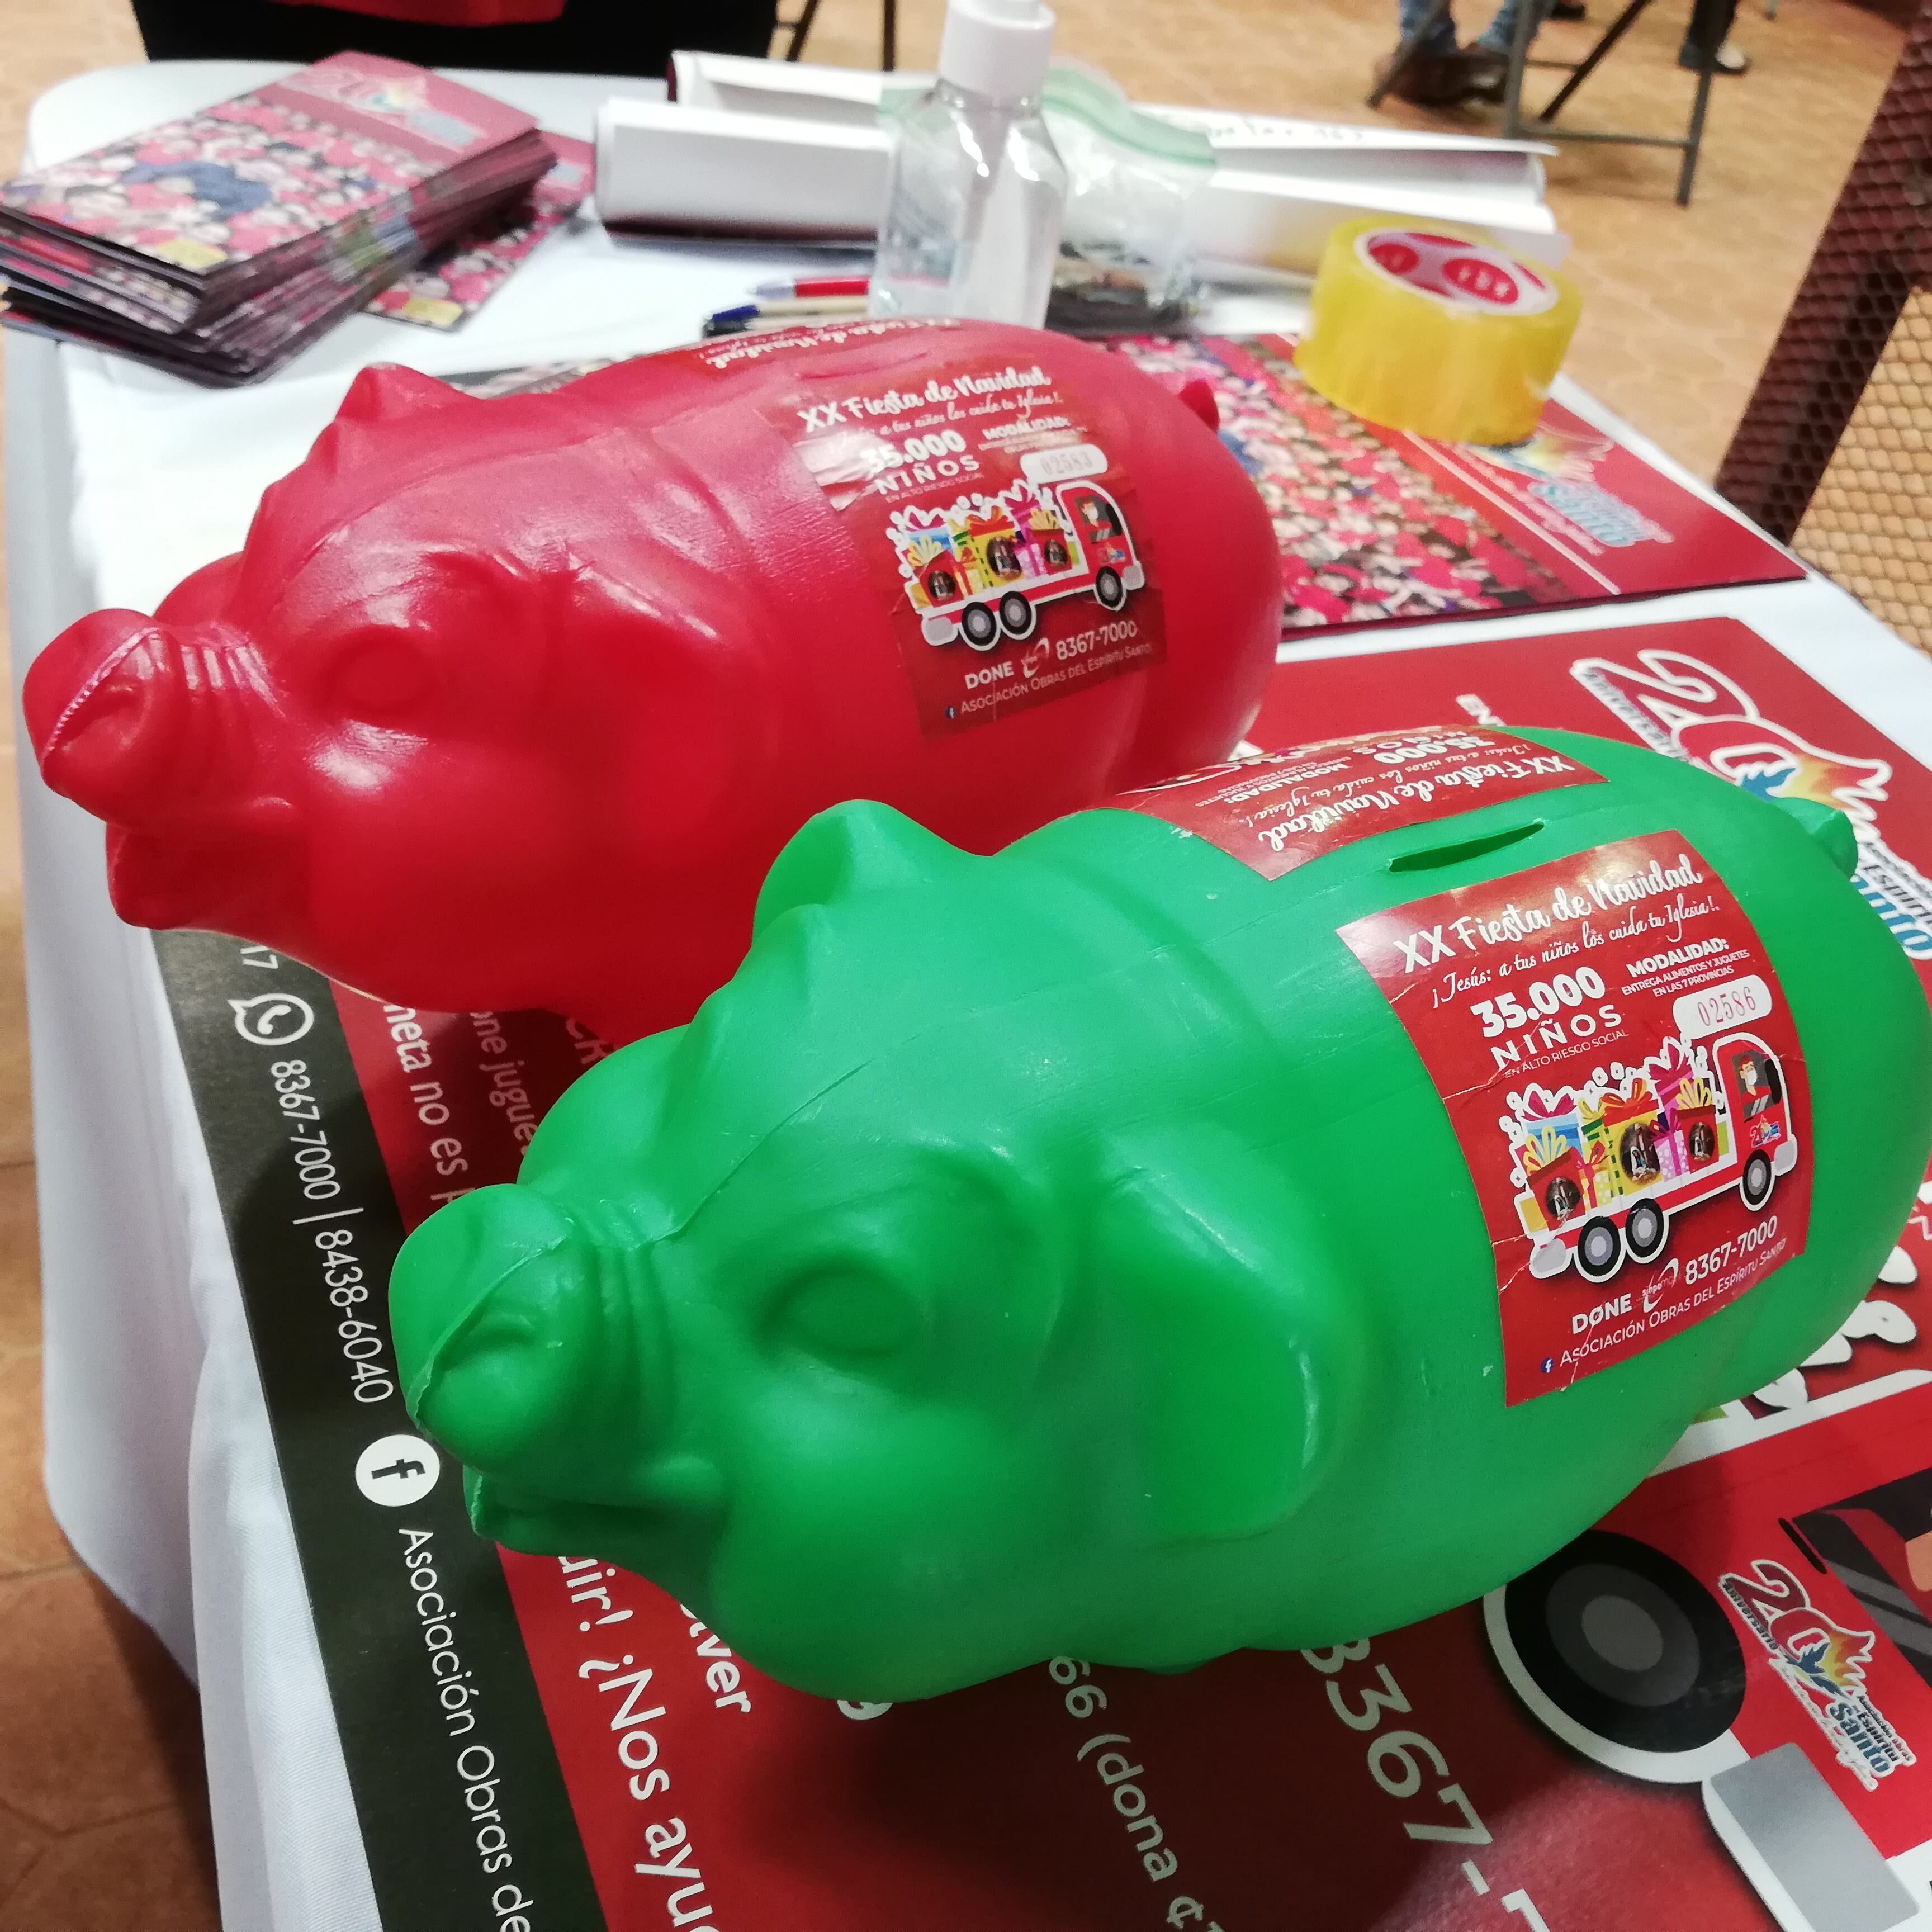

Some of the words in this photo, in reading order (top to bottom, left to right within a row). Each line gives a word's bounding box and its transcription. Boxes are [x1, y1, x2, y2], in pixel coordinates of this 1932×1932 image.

[797, 401, 847, 433] XX
[841, 389, 924, 418] Fiesta
[924, 380, 958, 402] de
[953, 366, 1052, 396] Navidad
[860, 429, 967, 473] 35.000
[874, 455, 980, 495] NIÑOS
[964, 661, 1015, 689] DONE
[1055, 620, 1138, 660] 8367-7000
[960, 680, 1029, 715] ASOCIACIÓN
[1374, 736, 1496, 764] 35.000
[1405, 759, 1441, 773] niños
[1521, 755, 1575, 775] XX
[1224, 763, 1351, 804] MODALIDAD:
[1311, 788, 1332, 798] tu
[1333, 776, 1374, 797] cuida
[1379, 770, 1403, 783] los
[1393, 780, 1435, 802] de
[1435, 761, 1532, 788] Fiesta
[1258, 790, 1399, 851] Navidad
[1393, 925, 1456, 973] XX
[1448, 903, 1551, 950] Fiesta
[1552, 887, 1592, 921] de
[1586, 854, 1703, 910] Navidad
[1432, 966, 1491, 1010] ¡Jesús:
[1499, 963, 1512, 977] a
[1513, 954, 1537, 971] tus
[1541, 941, 1579, 963] niños
[1582, 921, 1604, 949] los
[1609, 906, 1647, 941] cuida
[1648, 912, 1665, 927] tu
[1621, 976, 1664, 996] ENTREGA
[1663, 961, 1708, 982] ALIMENTOS
[1705, 960, 1713, 968] Y
[1712, 949, 1750, 967] JUGUETES
[1626, 937, 1730, 978] MODALIDAD:
[1470, 967, 1606, 1038] 35.000
[1652, 987, 1668, 997] EN
[1666, 981, 1683, 993] LAS
[1683, 979, 1689, 988] 7
[1688, 965, 1735, 987] PROVINCIAS
[1697, 986, 1756, 1027] 02586
[1490, 1005, 1622, 1070] NIÑOS
[1522, 1055, 1551, 1072] ALTO
[1551, 1041, 1591, 1062] RIESGO
[1592, 1029, 1630, 1048] SOCIAL
[410, 1081, 450, 1126] no
[430, 1137, 469, 1177] es
[479, 1060, 538, 1156] jugue
[1571, 1293, 1633, 1335] DONE
[1685, 1215, 1778, 1285] 8367-7000
[1559, 1319, 1645, 1367] ASOCIACIÓN
[1649, 1297, 1690, 1328] OBRAS
[1693, 1287, 1715, 1306] DEL
[1717, 1259, 1759, 1294] ESPÍRITU
[1759, 1238, 1787, 1266] SANTO
[271, 1059, 340, 1200] 8367-7000
[314, 1229, 394, 1403] 8438-6040
[399, 1528, 479, 1738] Asociación
[457, 1745, 513, 1874] Obras
[680, 1603, 751, 1713] ver
[1076, 1733, 1178, 1883] (dona
[634, 1817, 721, 1932] ayu
